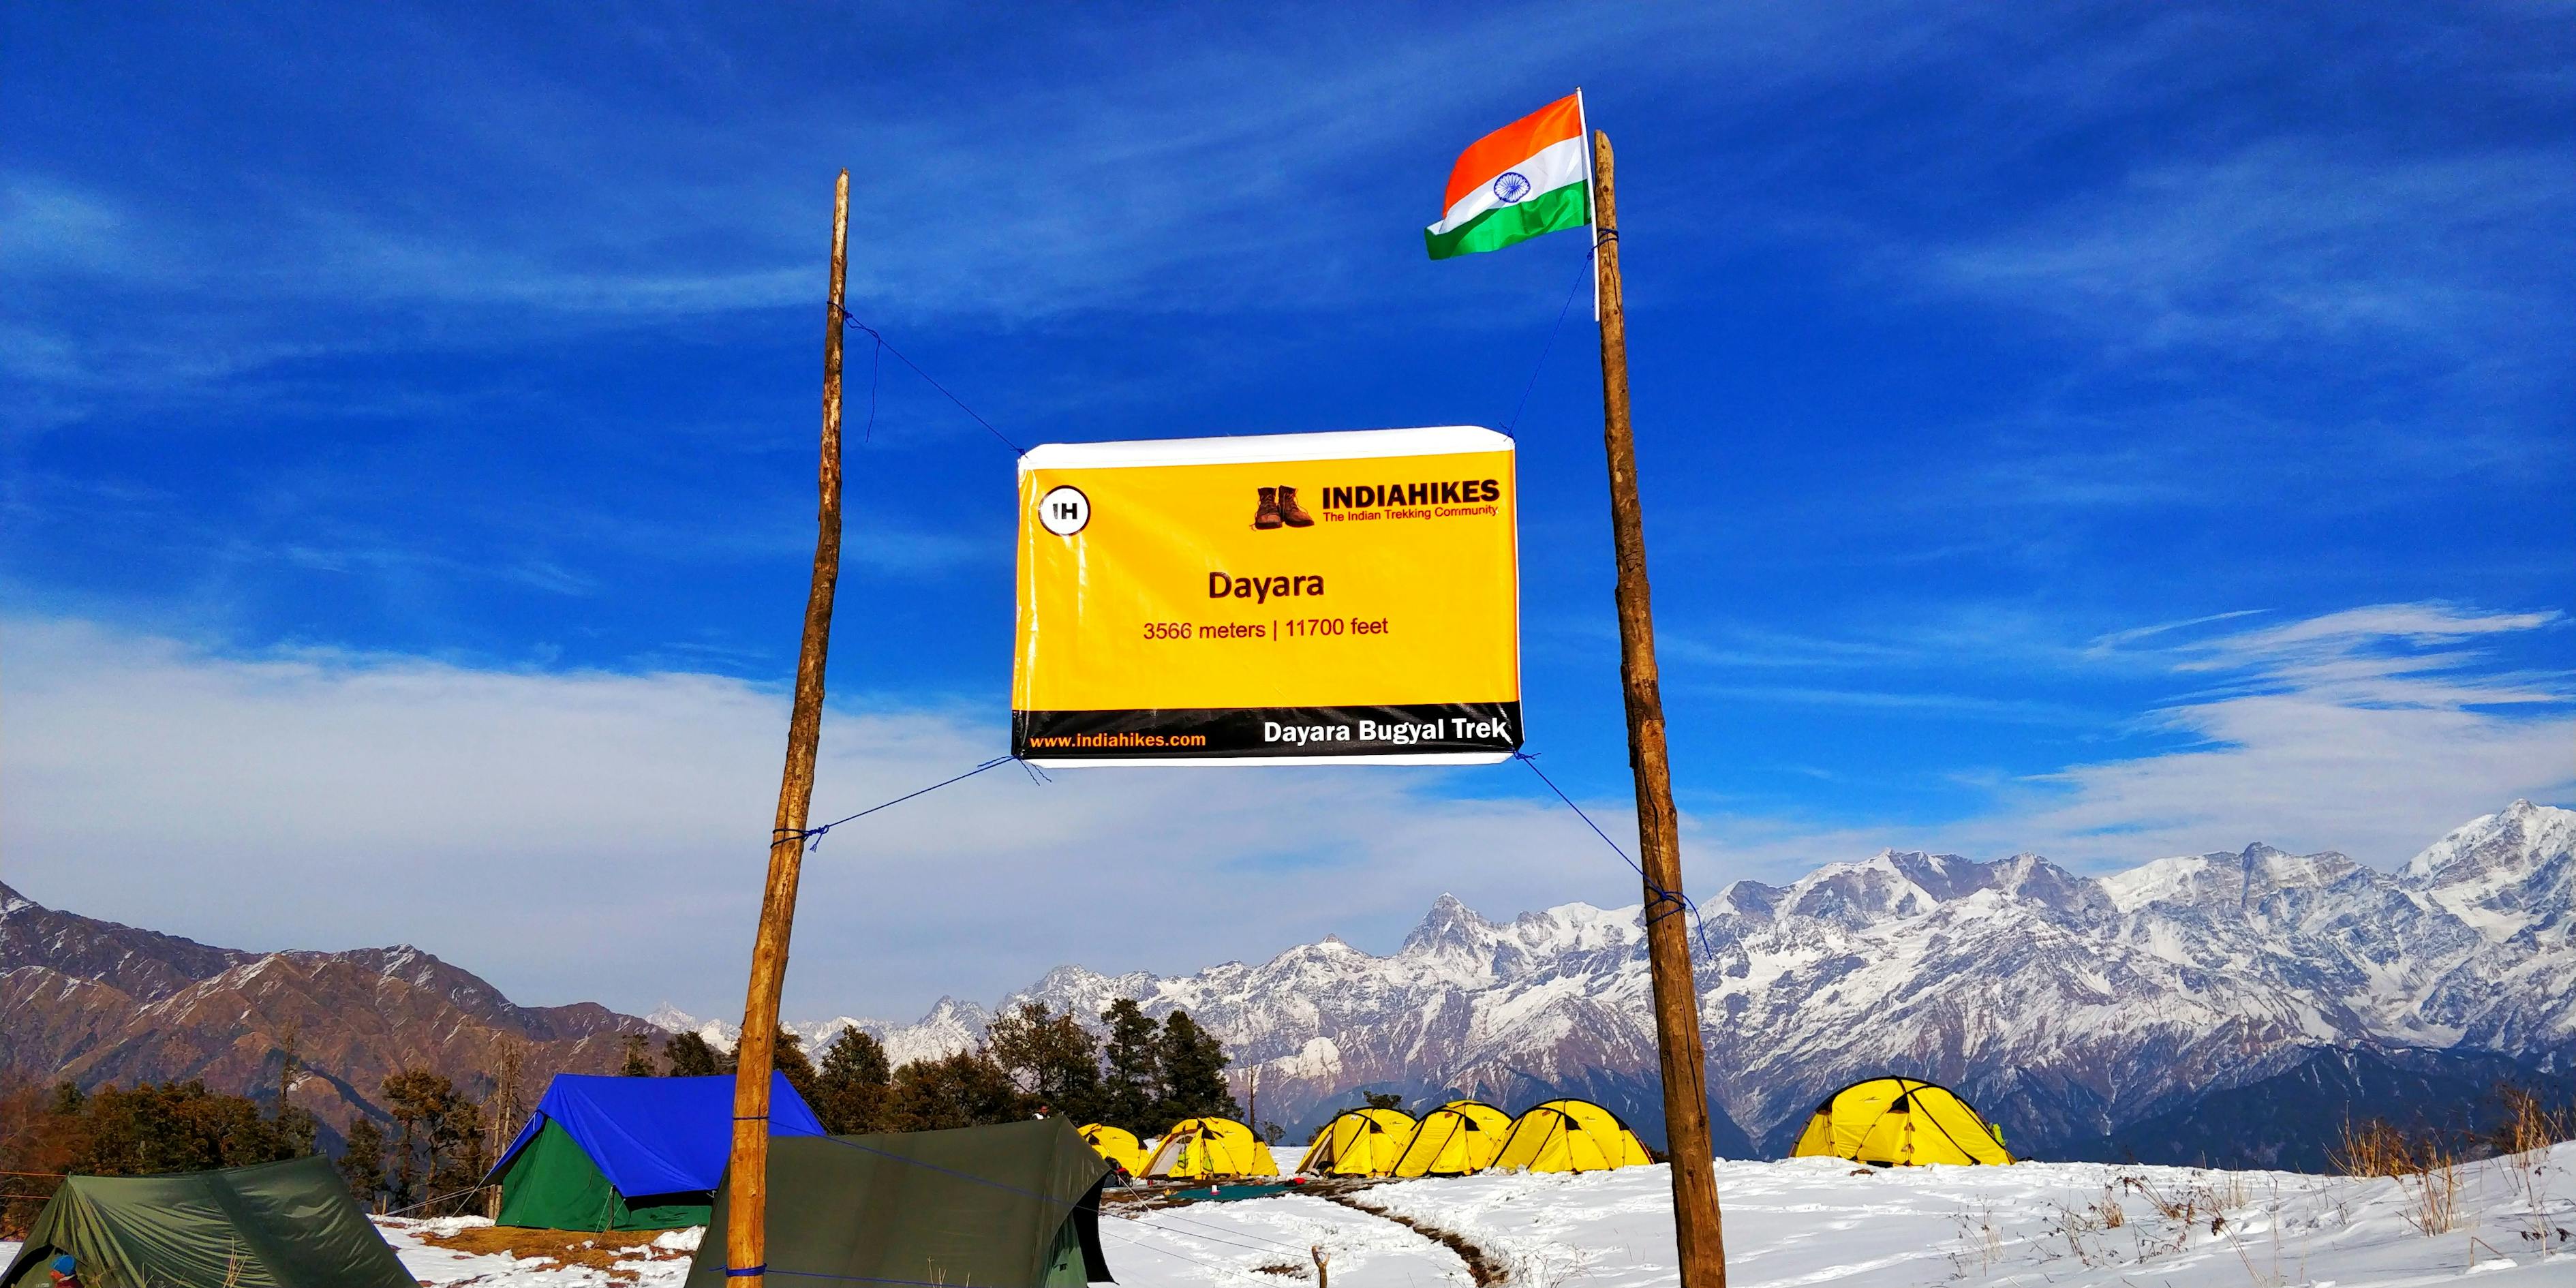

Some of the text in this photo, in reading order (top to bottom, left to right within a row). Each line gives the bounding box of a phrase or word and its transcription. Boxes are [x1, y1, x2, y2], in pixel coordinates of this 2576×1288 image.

[1322, 478, 1500, 510] INDIAHIKES
[1052, 503, 1078, 519] IH
[1323, 504, 1499, 522] The Indian Trekking Community
[1208, 571, 1324, 604] Dayara
[1143, 622, 1193, 639] 3566
[1199, 622, 1266, 639] meters
[1285, 619, 1345, 637] 11700
[1351, 617, 1389, 635] feet
[1030, 733, 1206, 748] www.indiahikes.com
[1264, 718, 1510, 747] Dayara Bugyal Trek
